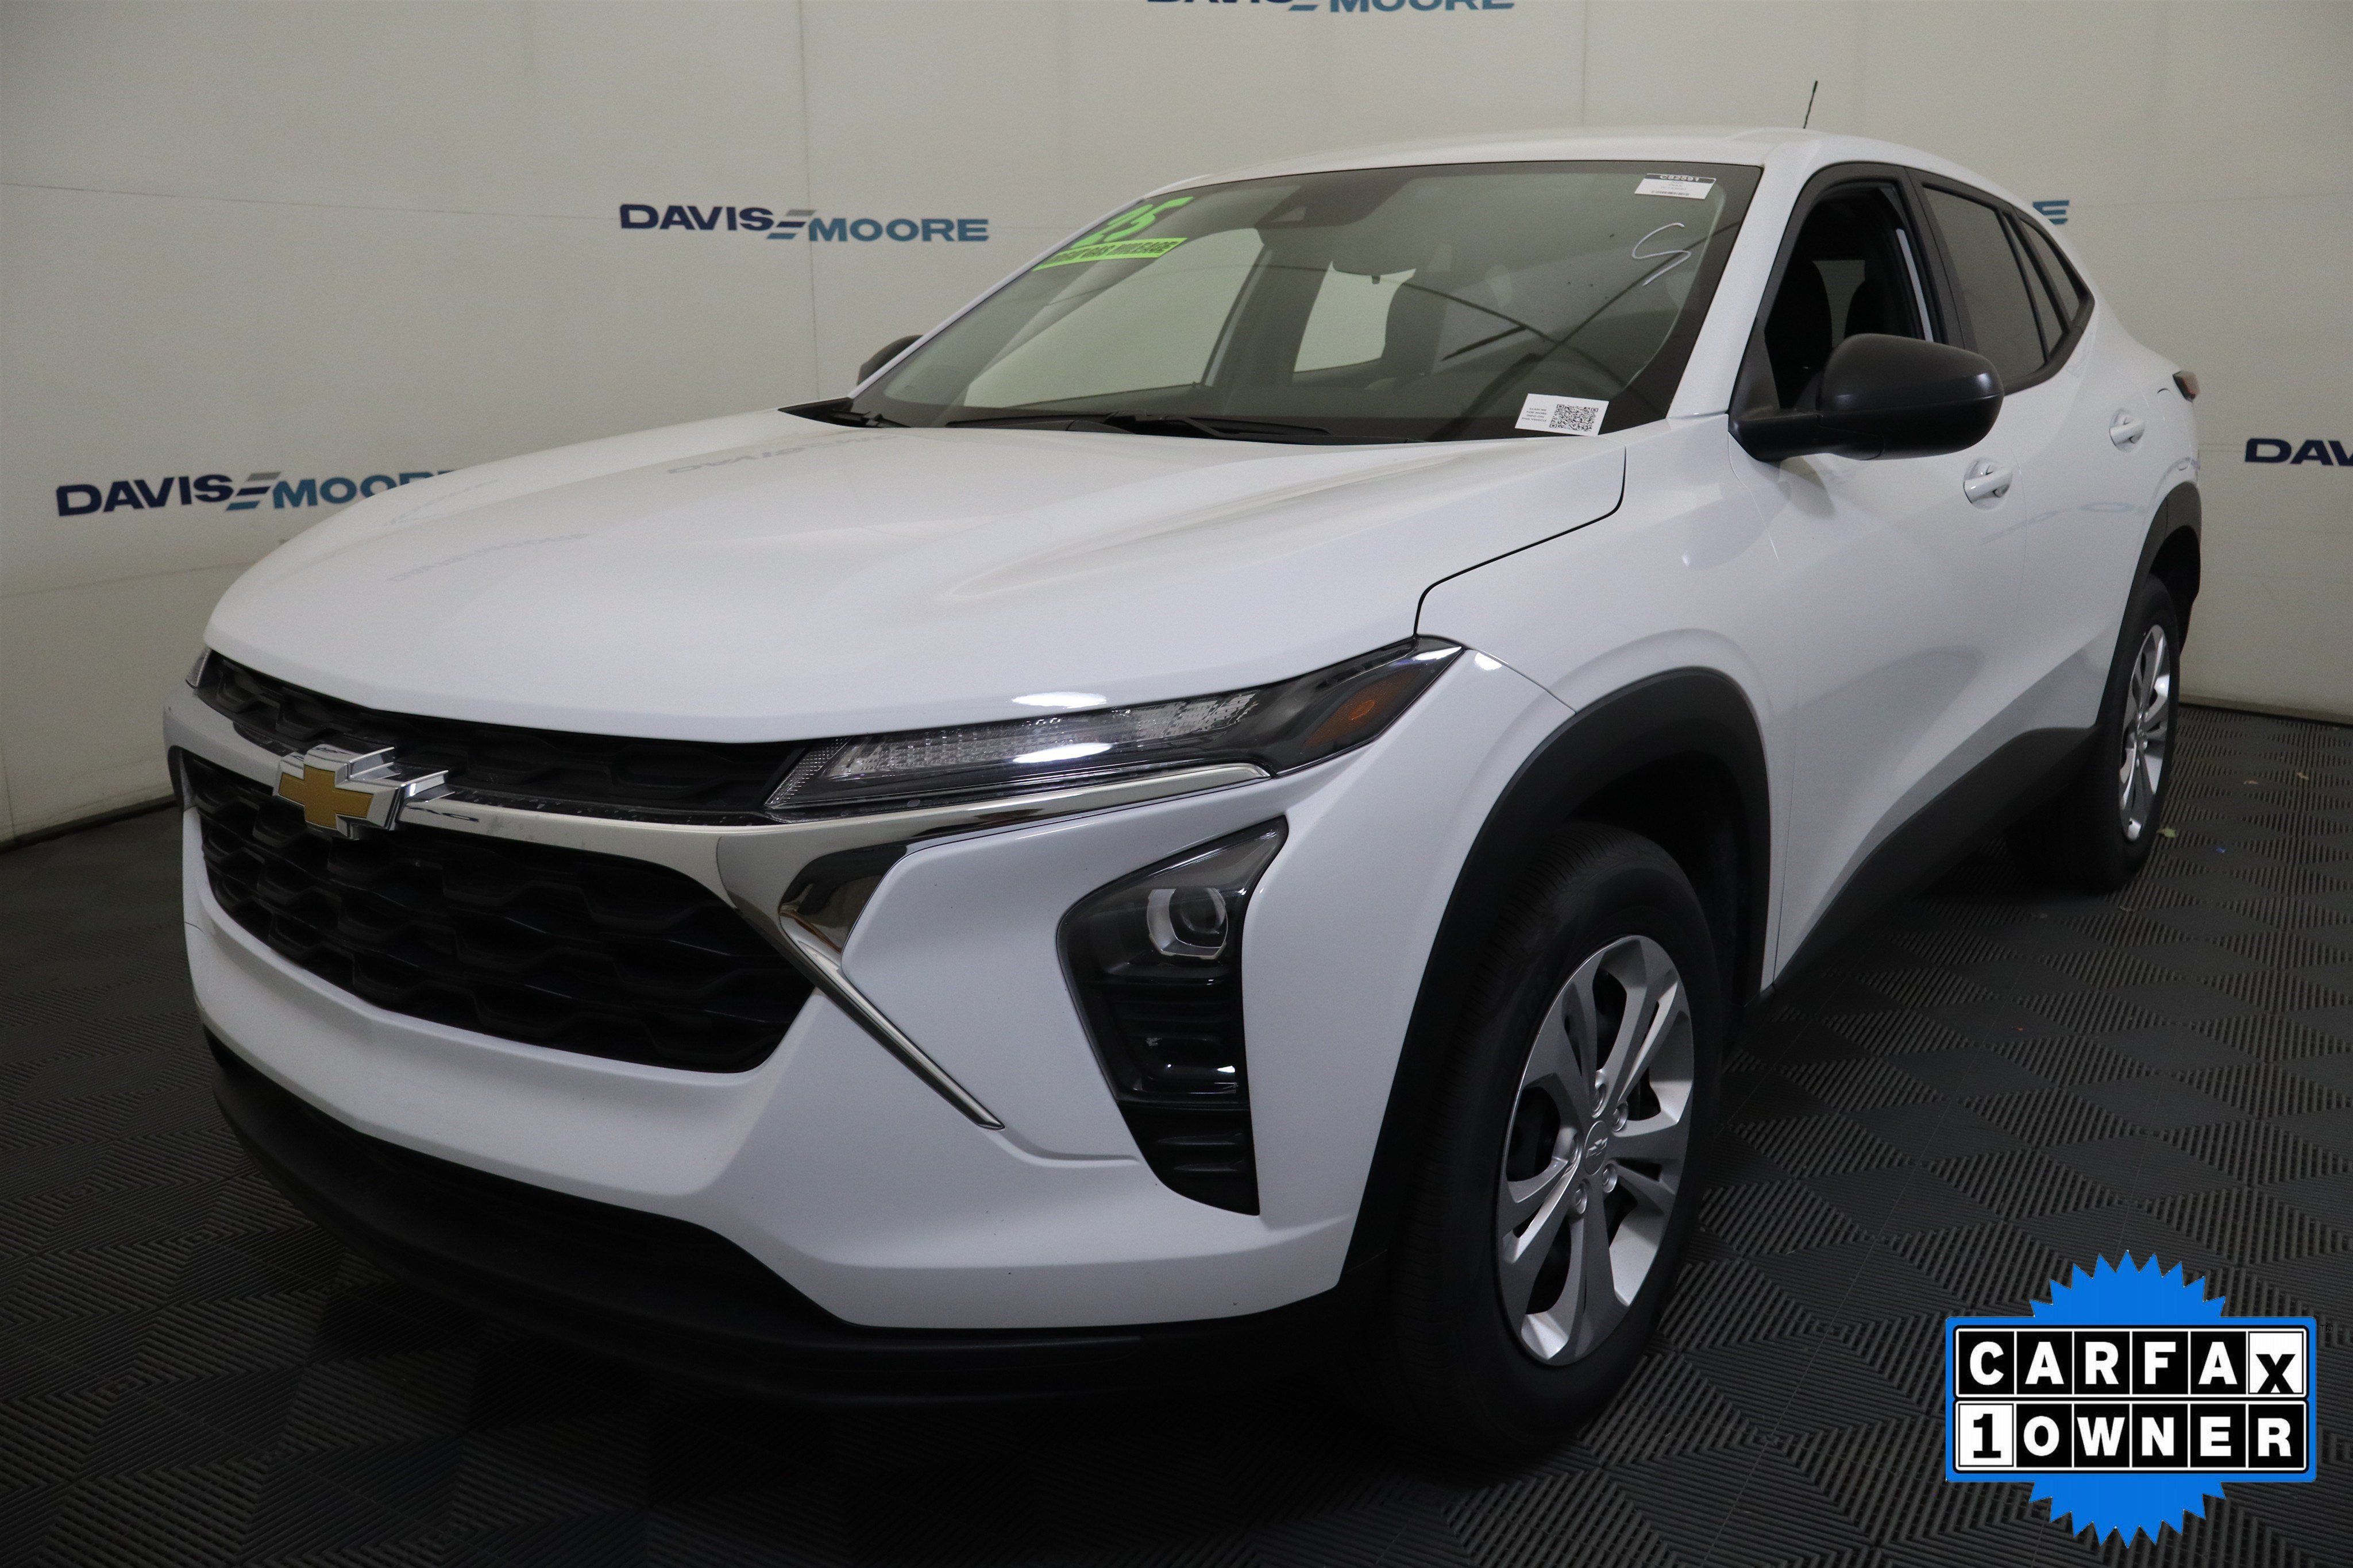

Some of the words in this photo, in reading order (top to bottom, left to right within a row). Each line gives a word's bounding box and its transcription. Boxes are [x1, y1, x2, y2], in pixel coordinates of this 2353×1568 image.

[619, 203, 774, 231] DAVIS
[808, 217, 989, 242] MOORE
[56, 474, 236, 517] DAVIS
[272, 470, 458, 509] MOO
